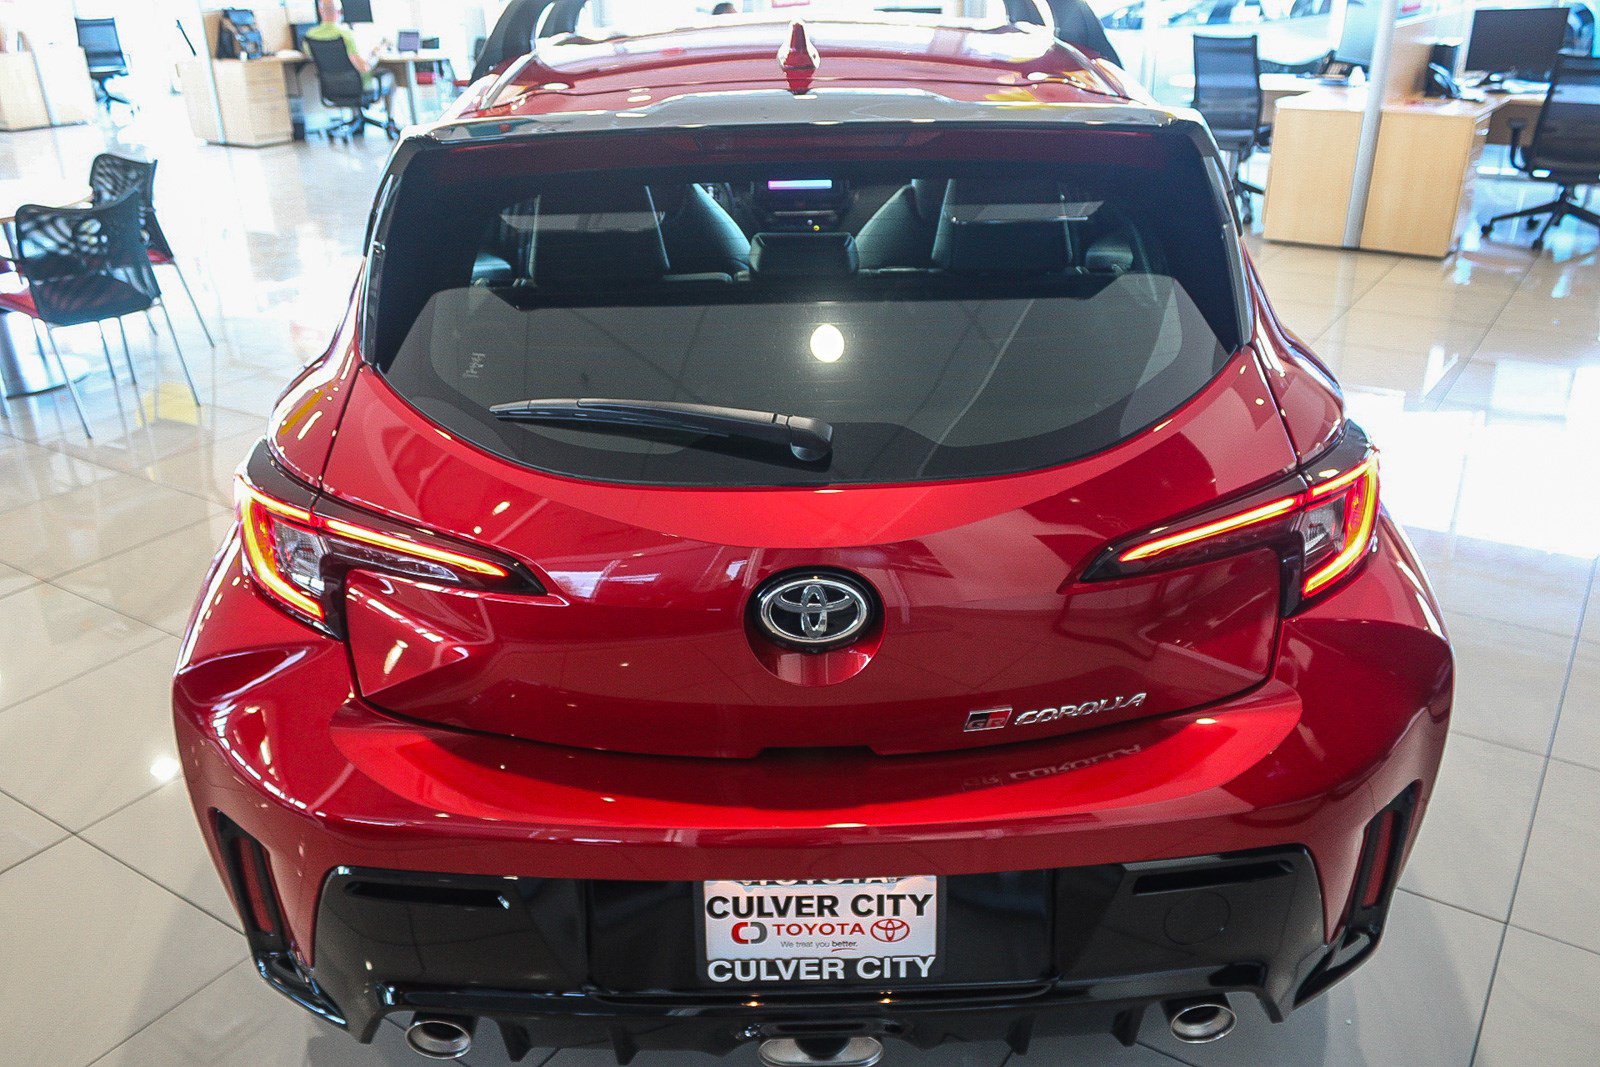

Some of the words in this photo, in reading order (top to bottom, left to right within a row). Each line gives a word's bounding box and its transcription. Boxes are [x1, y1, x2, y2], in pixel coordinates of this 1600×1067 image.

[1014, 692, 1147, 726] COROLLA
[706, 894, 839, 919] CULVER
[850, 893, 934, 917] CITY
[772, 922, 866, 936] TOYOTA
[780, 940, 794, 948] We
[796, 940, 813, 948] treat
[707, 957, 845, 982] CULVER
[856, 956, 936, 980] CITY
